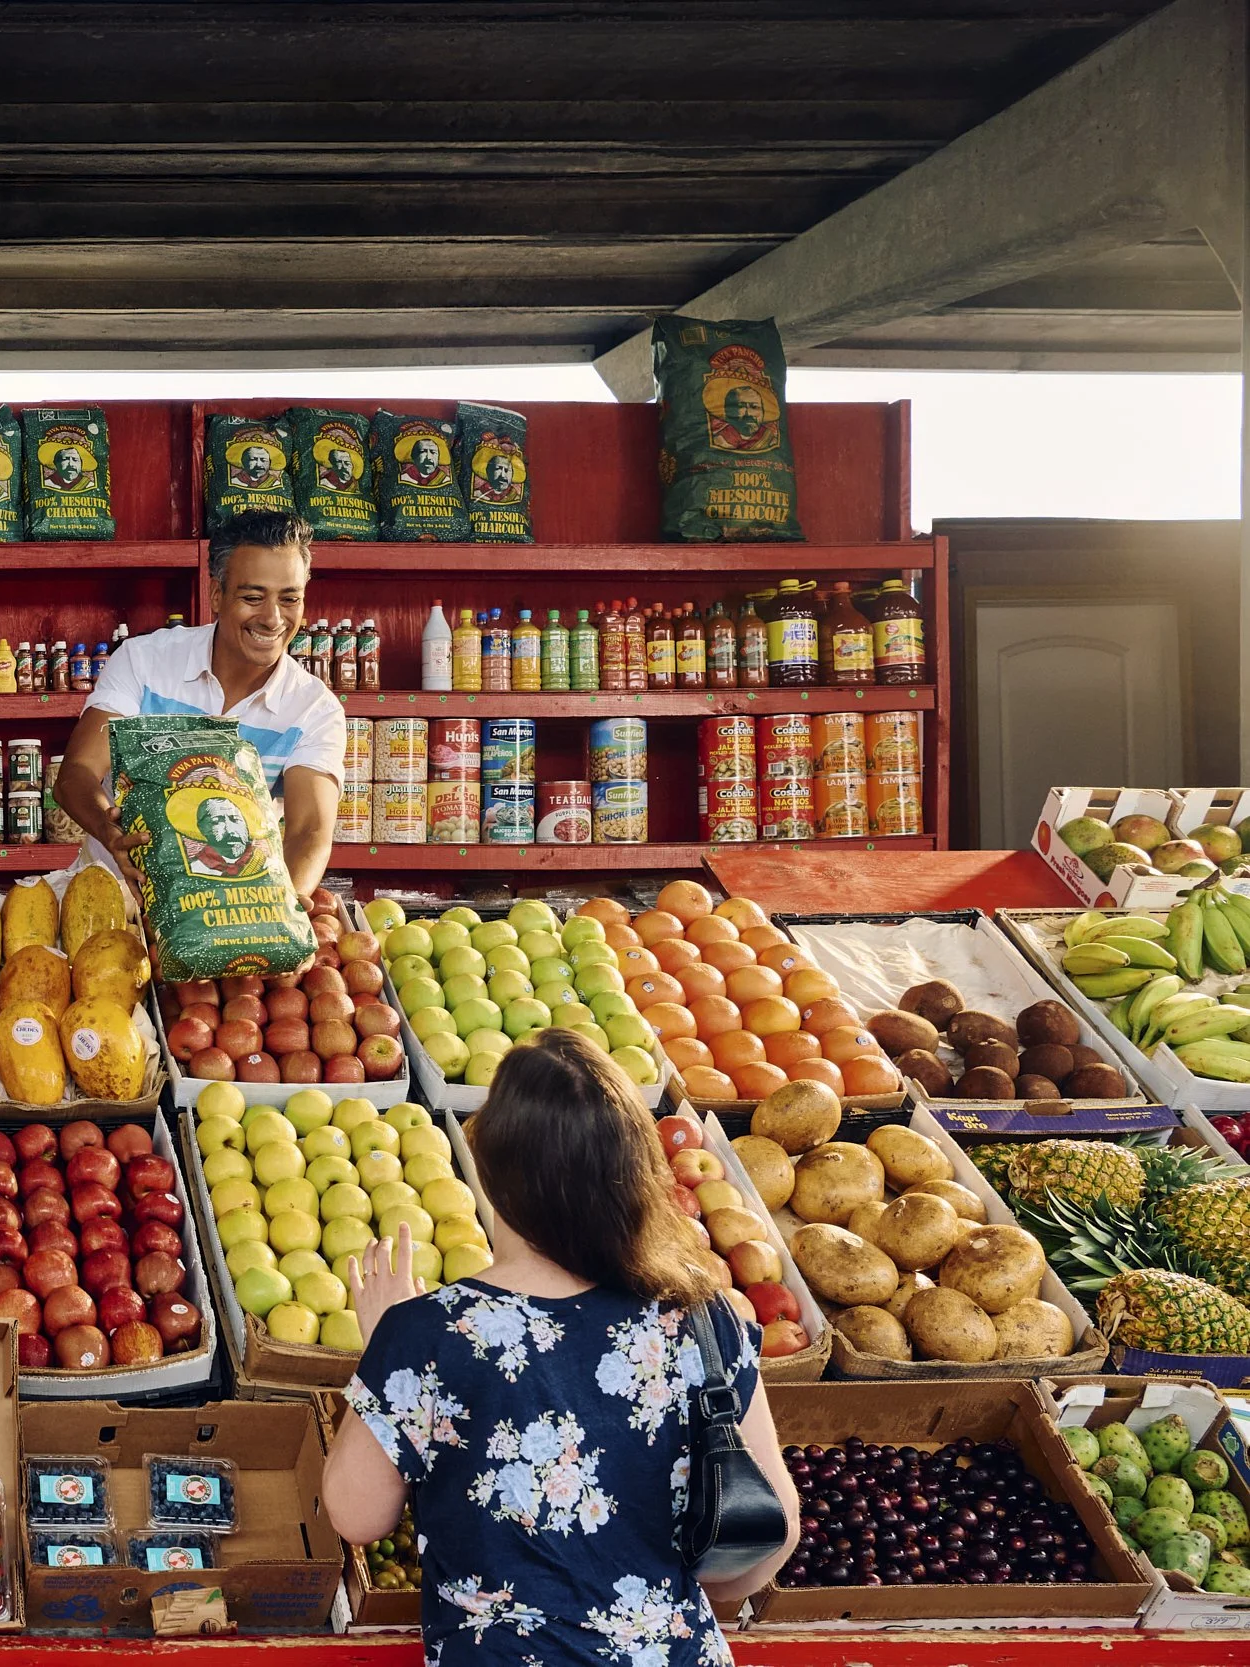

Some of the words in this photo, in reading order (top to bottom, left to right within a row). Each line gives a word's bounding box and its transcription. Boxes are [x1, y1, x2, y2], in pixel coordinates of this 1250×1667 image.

[711, 349, 732, 366] VIVA
[732, 346, 766, 369] PANCHO
[60, 425, 86, 437] PANCHO
[333, 421, 358, 439] PANCHO
[733, 471, 771, 489] 100%
[35, 497, 58, 509] 100%
[60, 496, 108, 508] MESQUITE
[221, 494, 245, 506] 100%
[247, 493, 294, 508] MESQUITE
[309, 496, 334, 508] 100%
[335, 495, 378, 512] MESQUITE
[390, 495, 414, 507] 100%
[416, 494, 463, 509] MESQUITE
[709, 488, 790, 506] MESQUITE
[46, 506, 99, 518] CHARCOAL
[322, 507, 371, 521] CHARCOAL
[402, 506, 454, 517] CHARCOAL
[707, 504, 789, 523] CHARCOAL
[474, 522, 526, 535] CHARCOAL
[782, 630, 817, 643] MEGA
[824, 717, 834, 725] LA
[875, 716, 886, 724] LA
[492, 727, 507, 736] San
[507, 727, 533, 737] Marcos
[776, 736, 810, 744] NACHOS
[171, 758, 191, 779] VIVA
[190, 755, 235, 776] PANCHO
[826, 779, 836, 787] LA
[493, 787, 509, 796] San
[509, 787, 533, 796] Marcos
[607, 791, 641, 800] Sunfield
[435, 793, 459, 804] DEL
[464, 793, 480, 803] SOL
[549, 796, 592, 805] TEASDALE
[774, 798, 810, 806] NACHOS
[1050, 855, 1066, 877] Fresh
[1066, 873, 1092, 905] Mangoes
[178, 891, 221, 913] 100%
[202, 904, 290, 928] CHARCOAL
[946, 1112, 981, 1123] Kapi
[963, 1121, 989, 1130] oro
